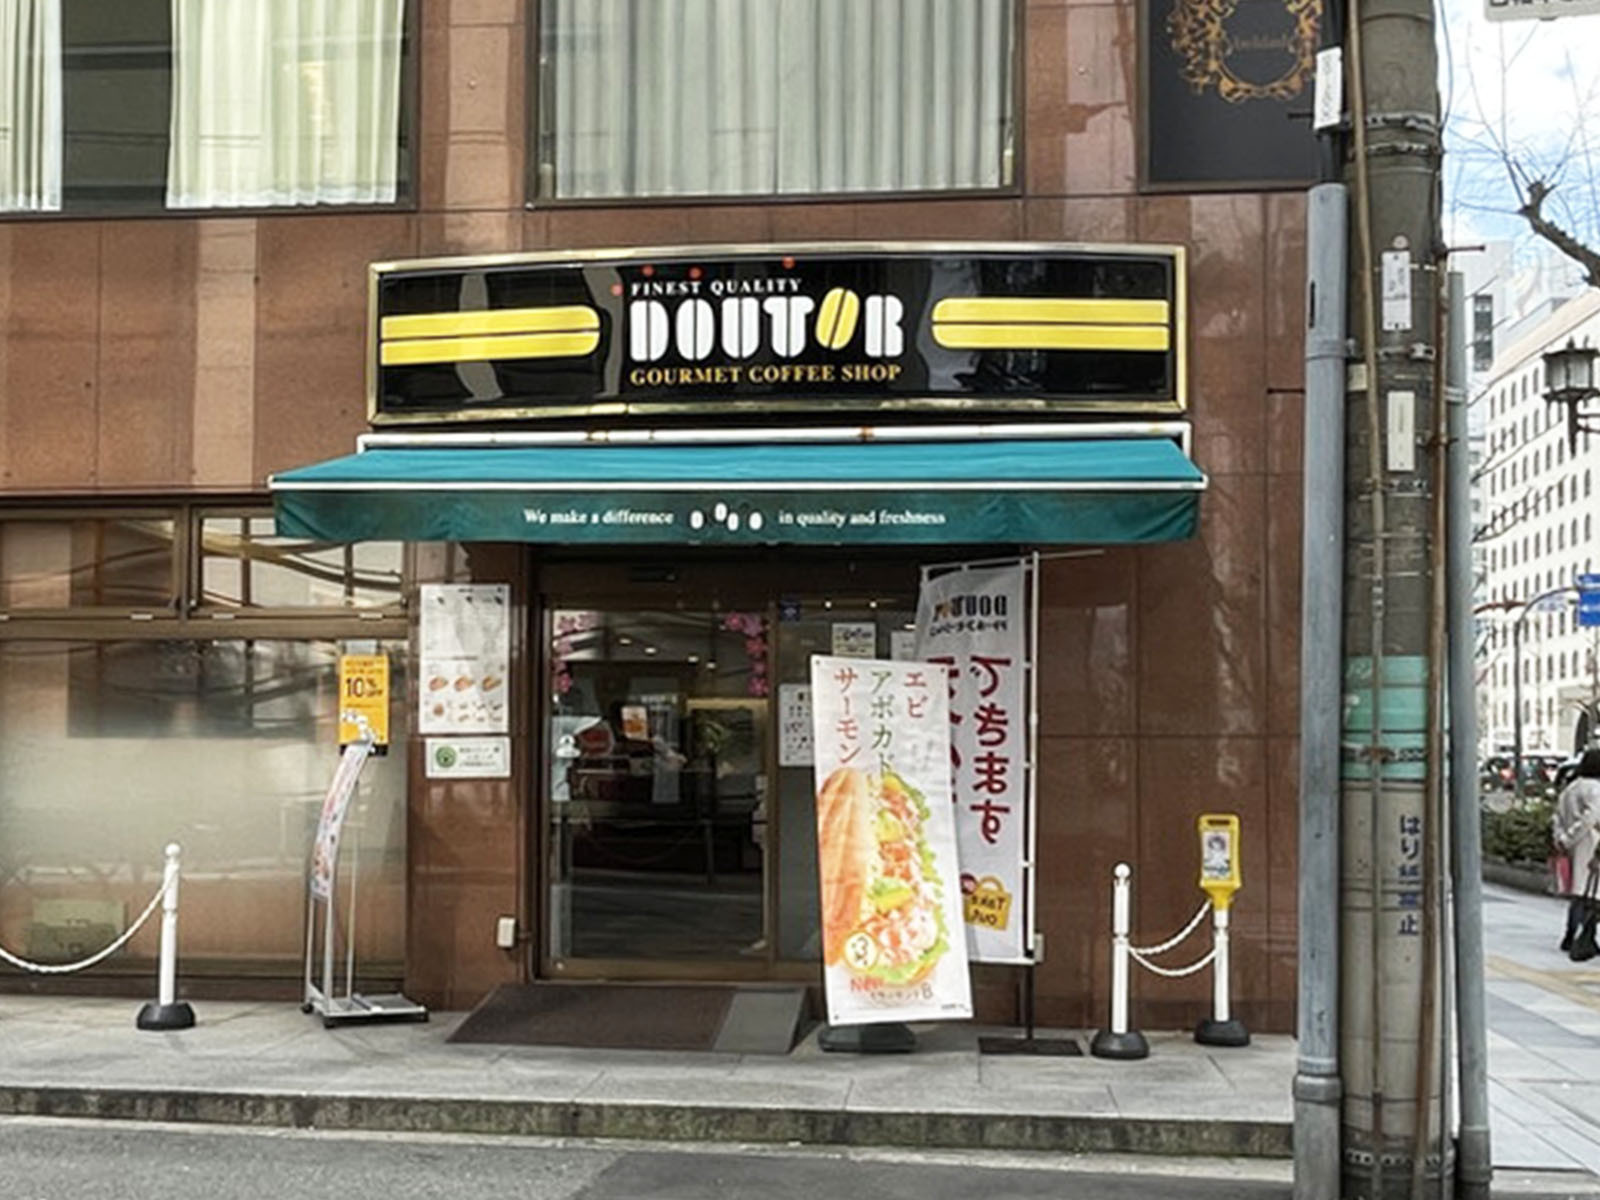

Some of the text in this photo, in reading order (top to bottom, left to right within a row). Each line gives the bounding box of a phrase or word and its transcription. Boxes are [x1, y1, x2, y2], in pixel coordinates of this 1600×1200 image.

[631, 279, 802, 296] FINEST QUALITY
[630, 287, 904, 362] DOUTOR
[630, 363, 902, 385] GOURMET COFFEE SHOP
[523, 508, 946, 528] We make a difference in quality and freshness
[834, 667, 861, 763] サーモン
[904, 672, 928, 718] エビ
[871, 670, 894, 778] アボカド
